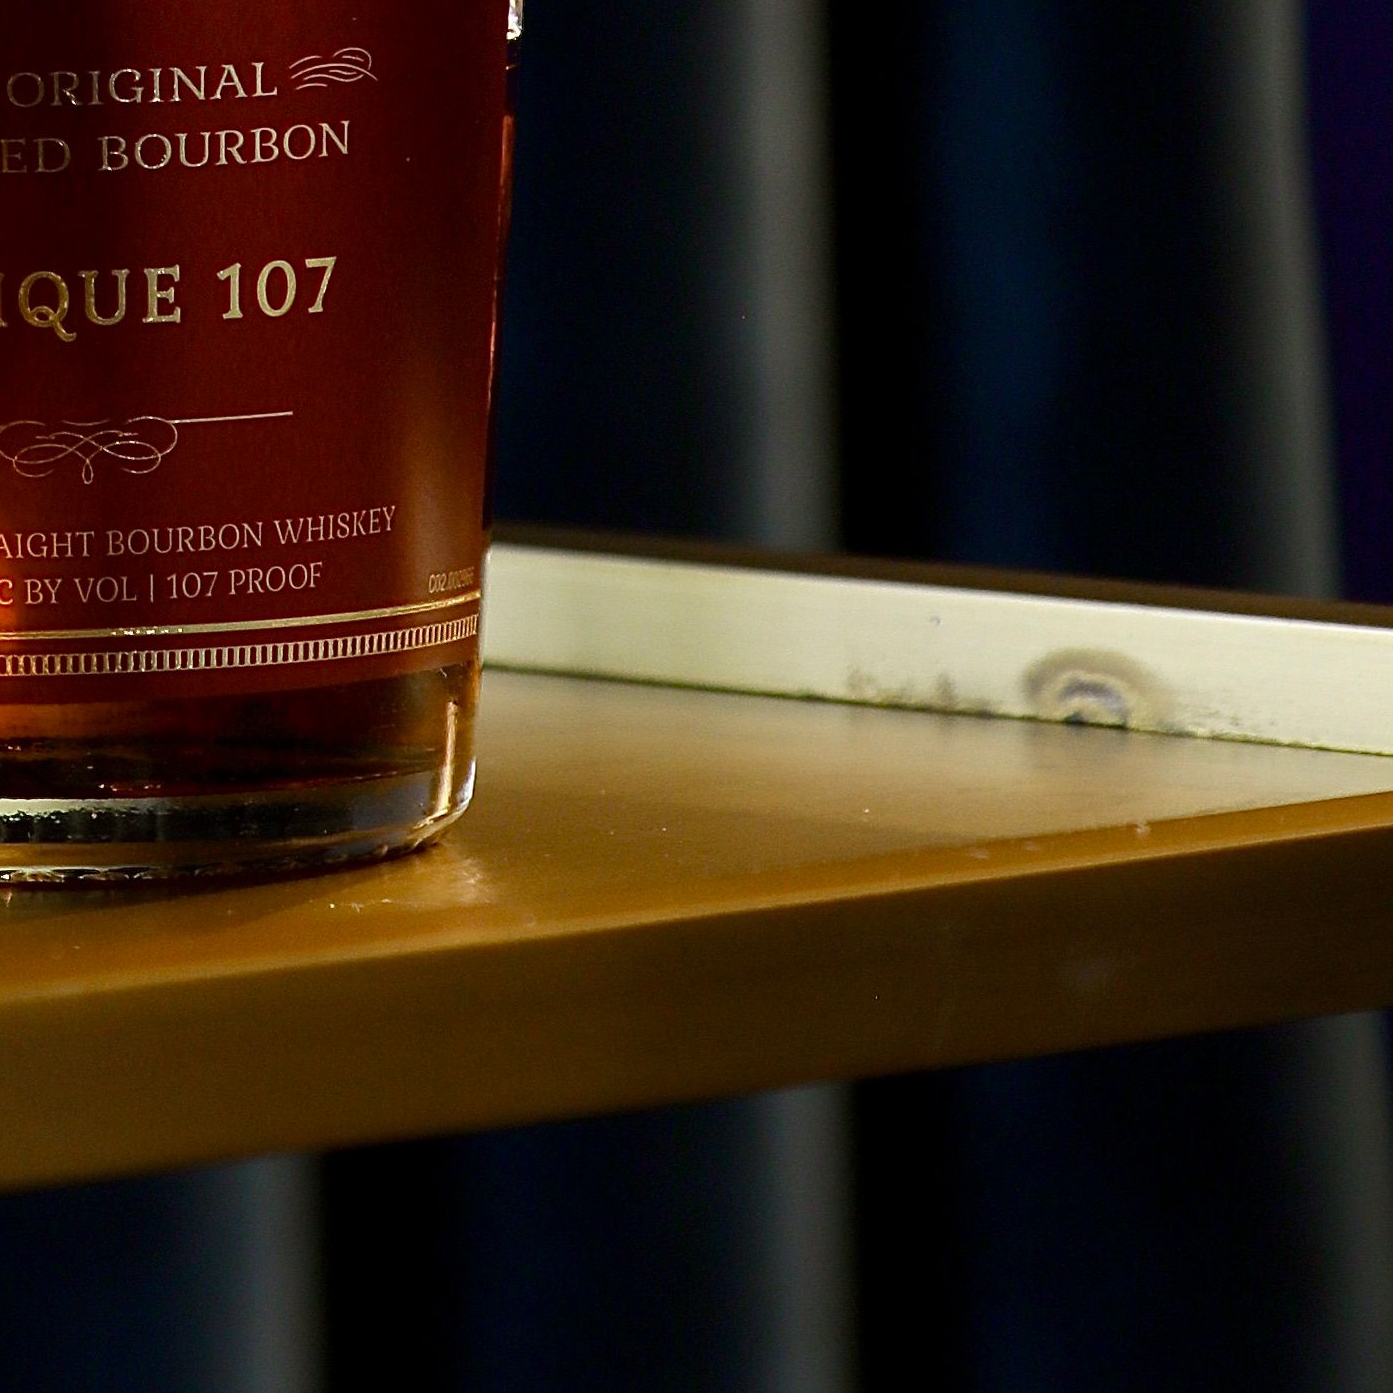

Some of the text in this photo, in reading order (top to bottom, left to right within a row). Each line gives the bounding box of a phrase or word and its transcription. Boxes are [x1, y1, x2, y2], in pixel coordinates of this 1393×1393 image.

[6, 61, 279, 107] ORIGINAL
[98, 120, 350, 172] BOURBON
[217, 256, 338, 320] 107
[106, 521, 264, 555] BOURBON
[273, 505, 397, 545] WHISKEY
[24, 577, 62, 604] BY
[74, 575, 137, 603] VOL
[166, 570, 218, 598] 107
[227, 561, 323, 596] PROOF
